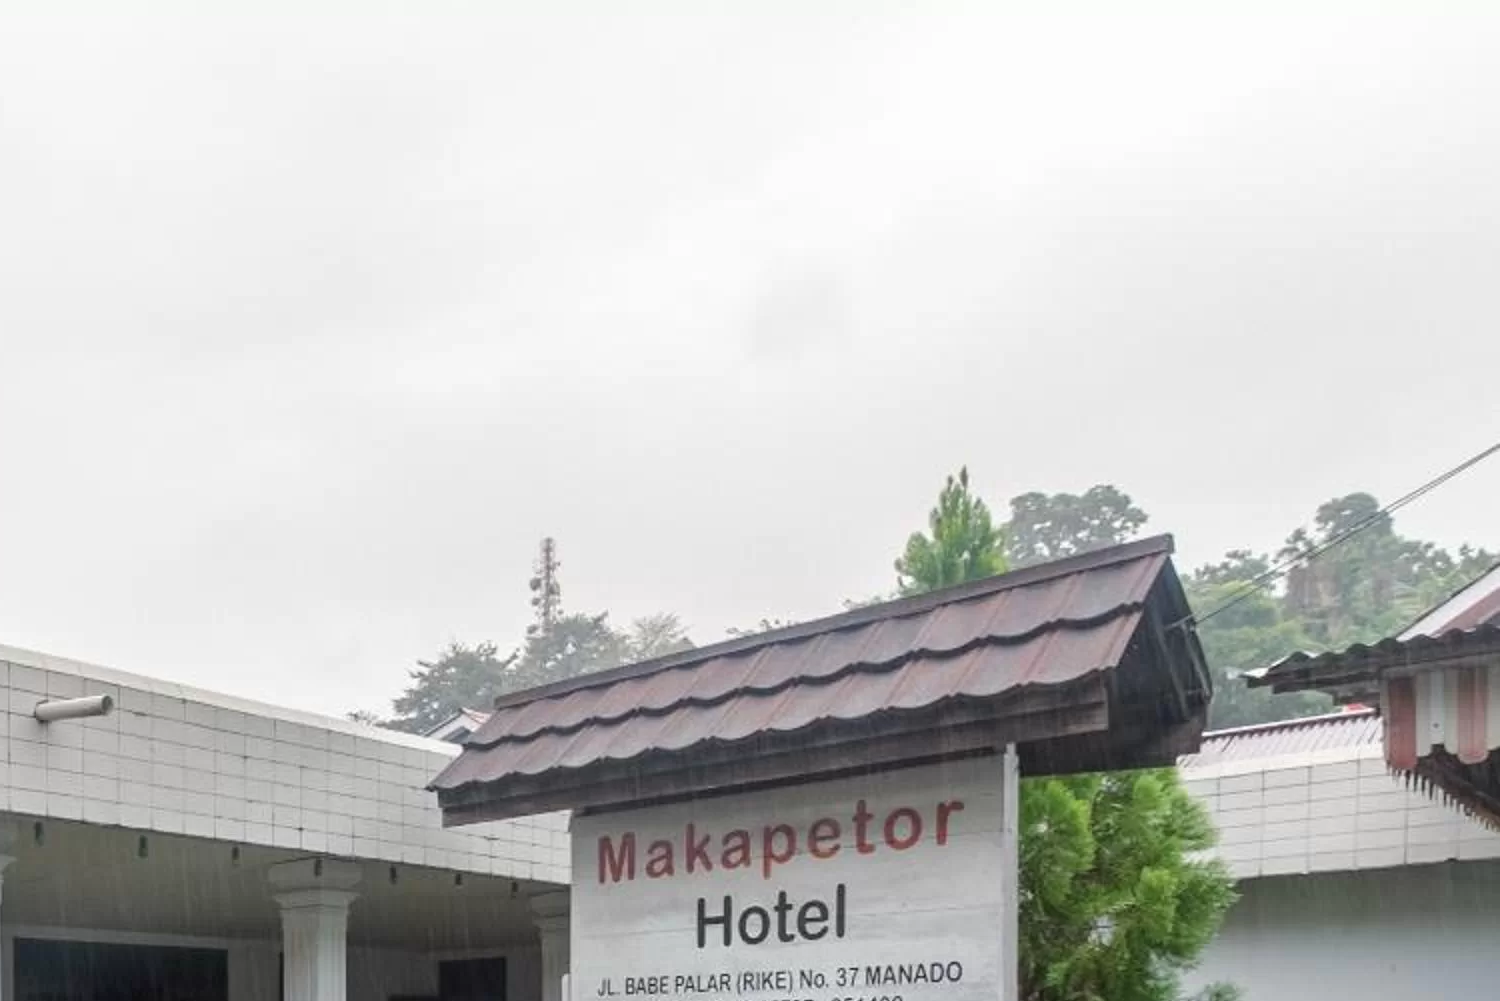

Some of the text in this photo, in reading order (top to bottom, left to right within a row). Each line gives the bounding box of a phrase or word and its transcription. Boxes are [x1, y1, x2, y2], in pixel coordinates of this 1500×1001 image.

[598, 799, 965, 884] Makapetor
[697, 883, 845, 949] Hotel
[597, 961, 964, 997] JL. BABE PALAR (RIKE) No. 37 MANADO
